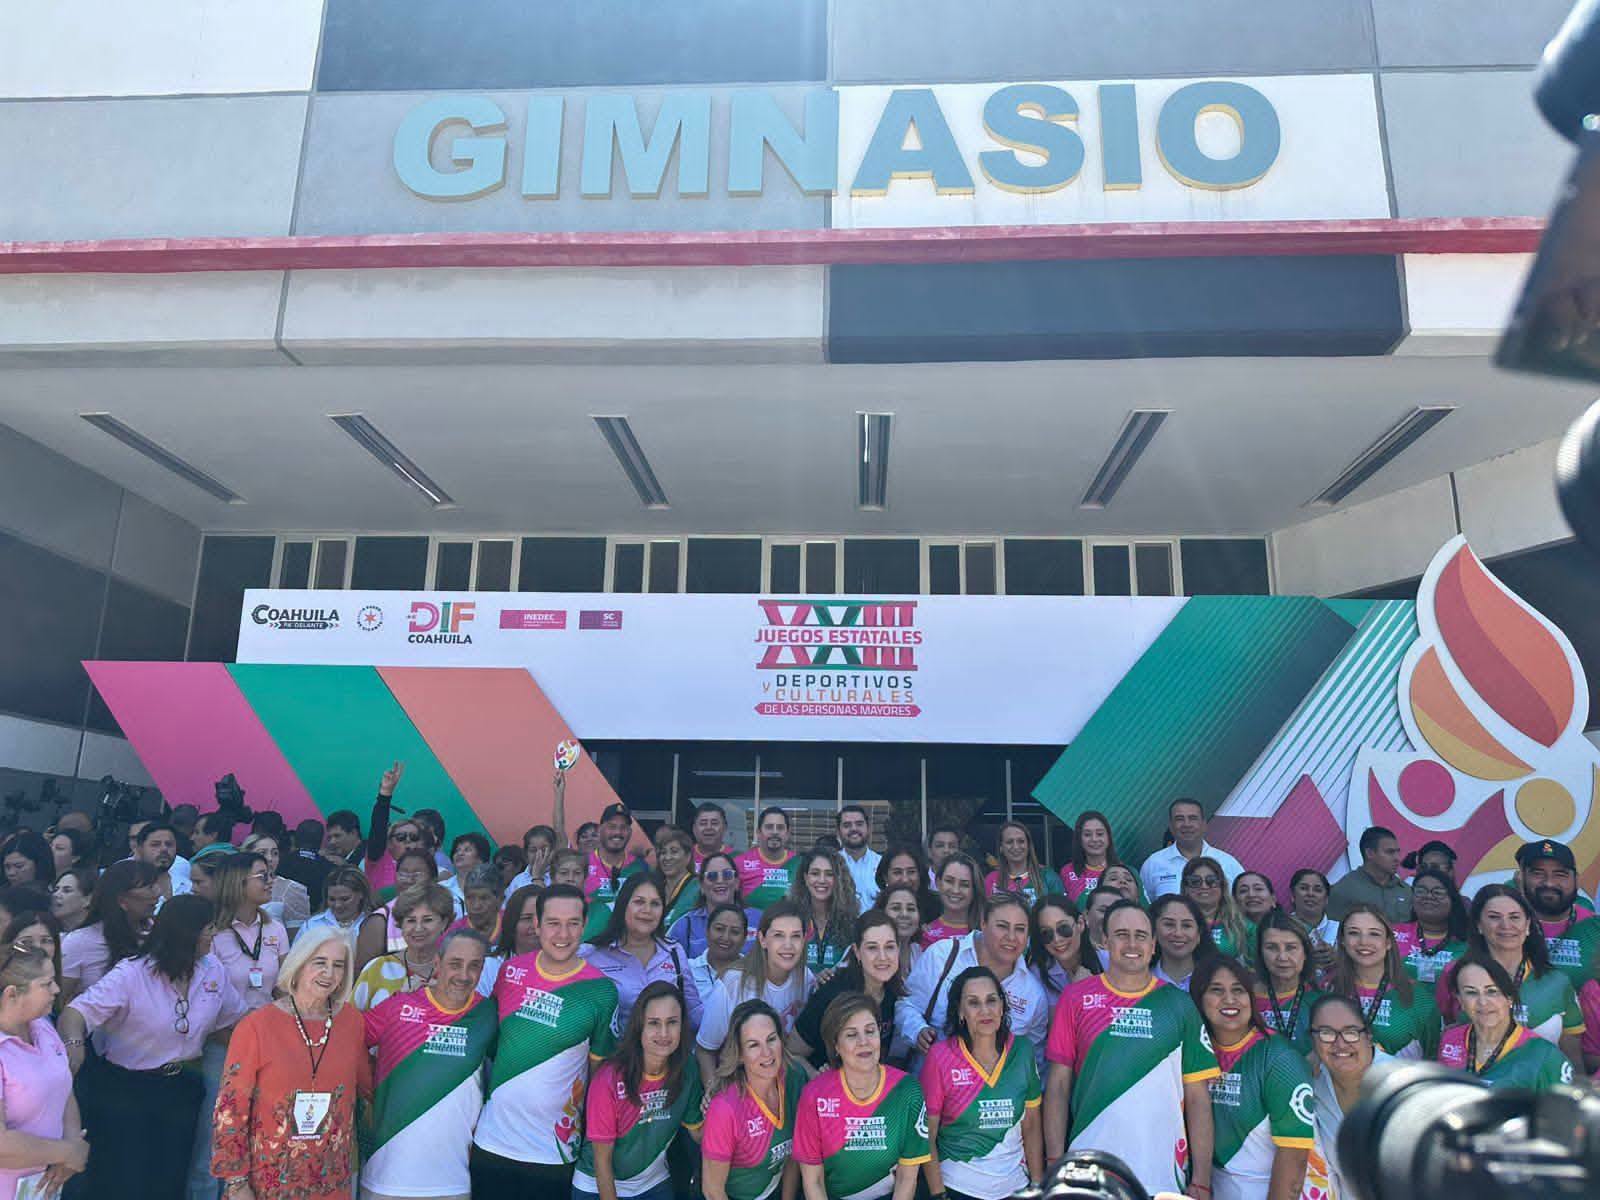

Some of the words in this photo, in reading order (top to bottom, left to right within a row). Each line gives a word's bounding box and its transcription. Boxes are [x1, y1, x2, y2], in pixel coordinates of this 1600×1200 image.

[393, 79, 1281, 202] GIMNASIO
[251, 604, 339, 624] COAHUILA
[408, 602, 476, 633] DIF
[408, 634, 473, 645] COAHUILA
[755, 629, 823, 643] JUEGOS
[829, 630, 923, 645] ESTATALES
[776, 674, 913, 689] DEPORTIVOS
[776, 689, 914, 703] CULTURALES
[764, 704, 778, 714] DE
[781, 704, 800, 715] LAS
[802, 704, 857, 717] PERSONAS
[860, 706, 912, 717] MAYORES
[817, 1097, 841, 1112] DIF
